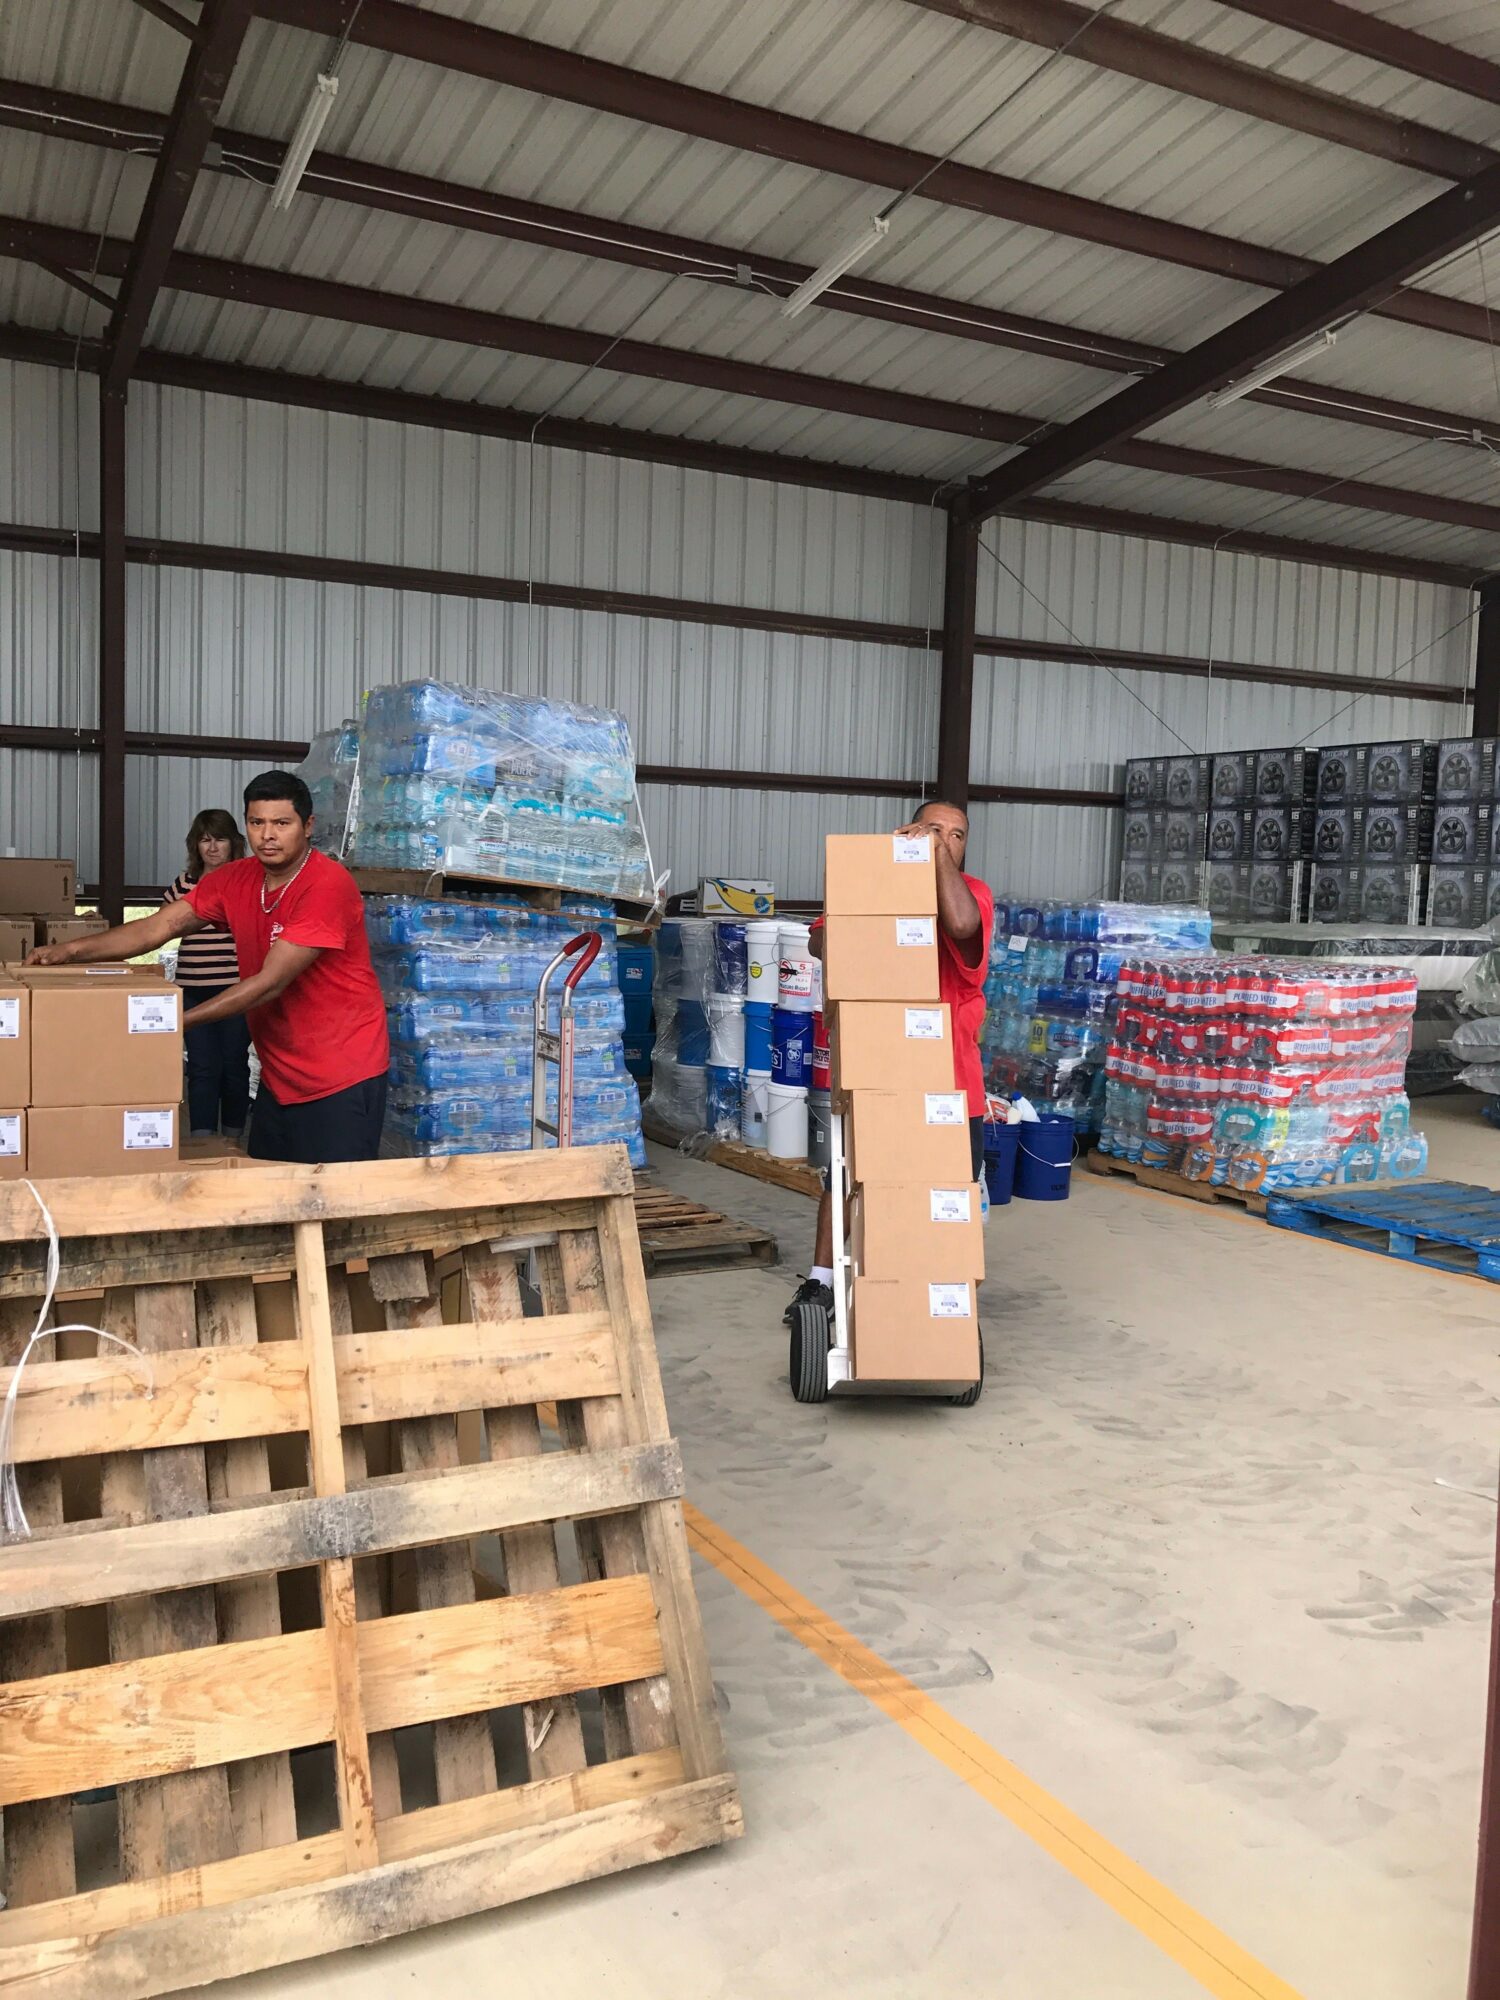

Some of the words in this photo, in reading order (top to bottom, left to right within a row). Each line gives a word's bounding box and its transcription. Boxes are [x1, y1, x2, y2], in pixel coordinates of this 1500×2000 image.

[1411, 747, 1421, 757] 16
[1482, 743, 1492, 753] 16
[1318, 808, 1346, 817] Hurricane
[1353, 811, 1362, 820] 16
[1369, 807, 1399, 816] Hurricane
[1407, 809, 1417, 819] 16
[1438, 806, 1470, 816] Hurricane
[1478, 808, 1488, 819] 16
[1474, 873, 1483, 883] 16
[799, 963, 806, 971] 5
